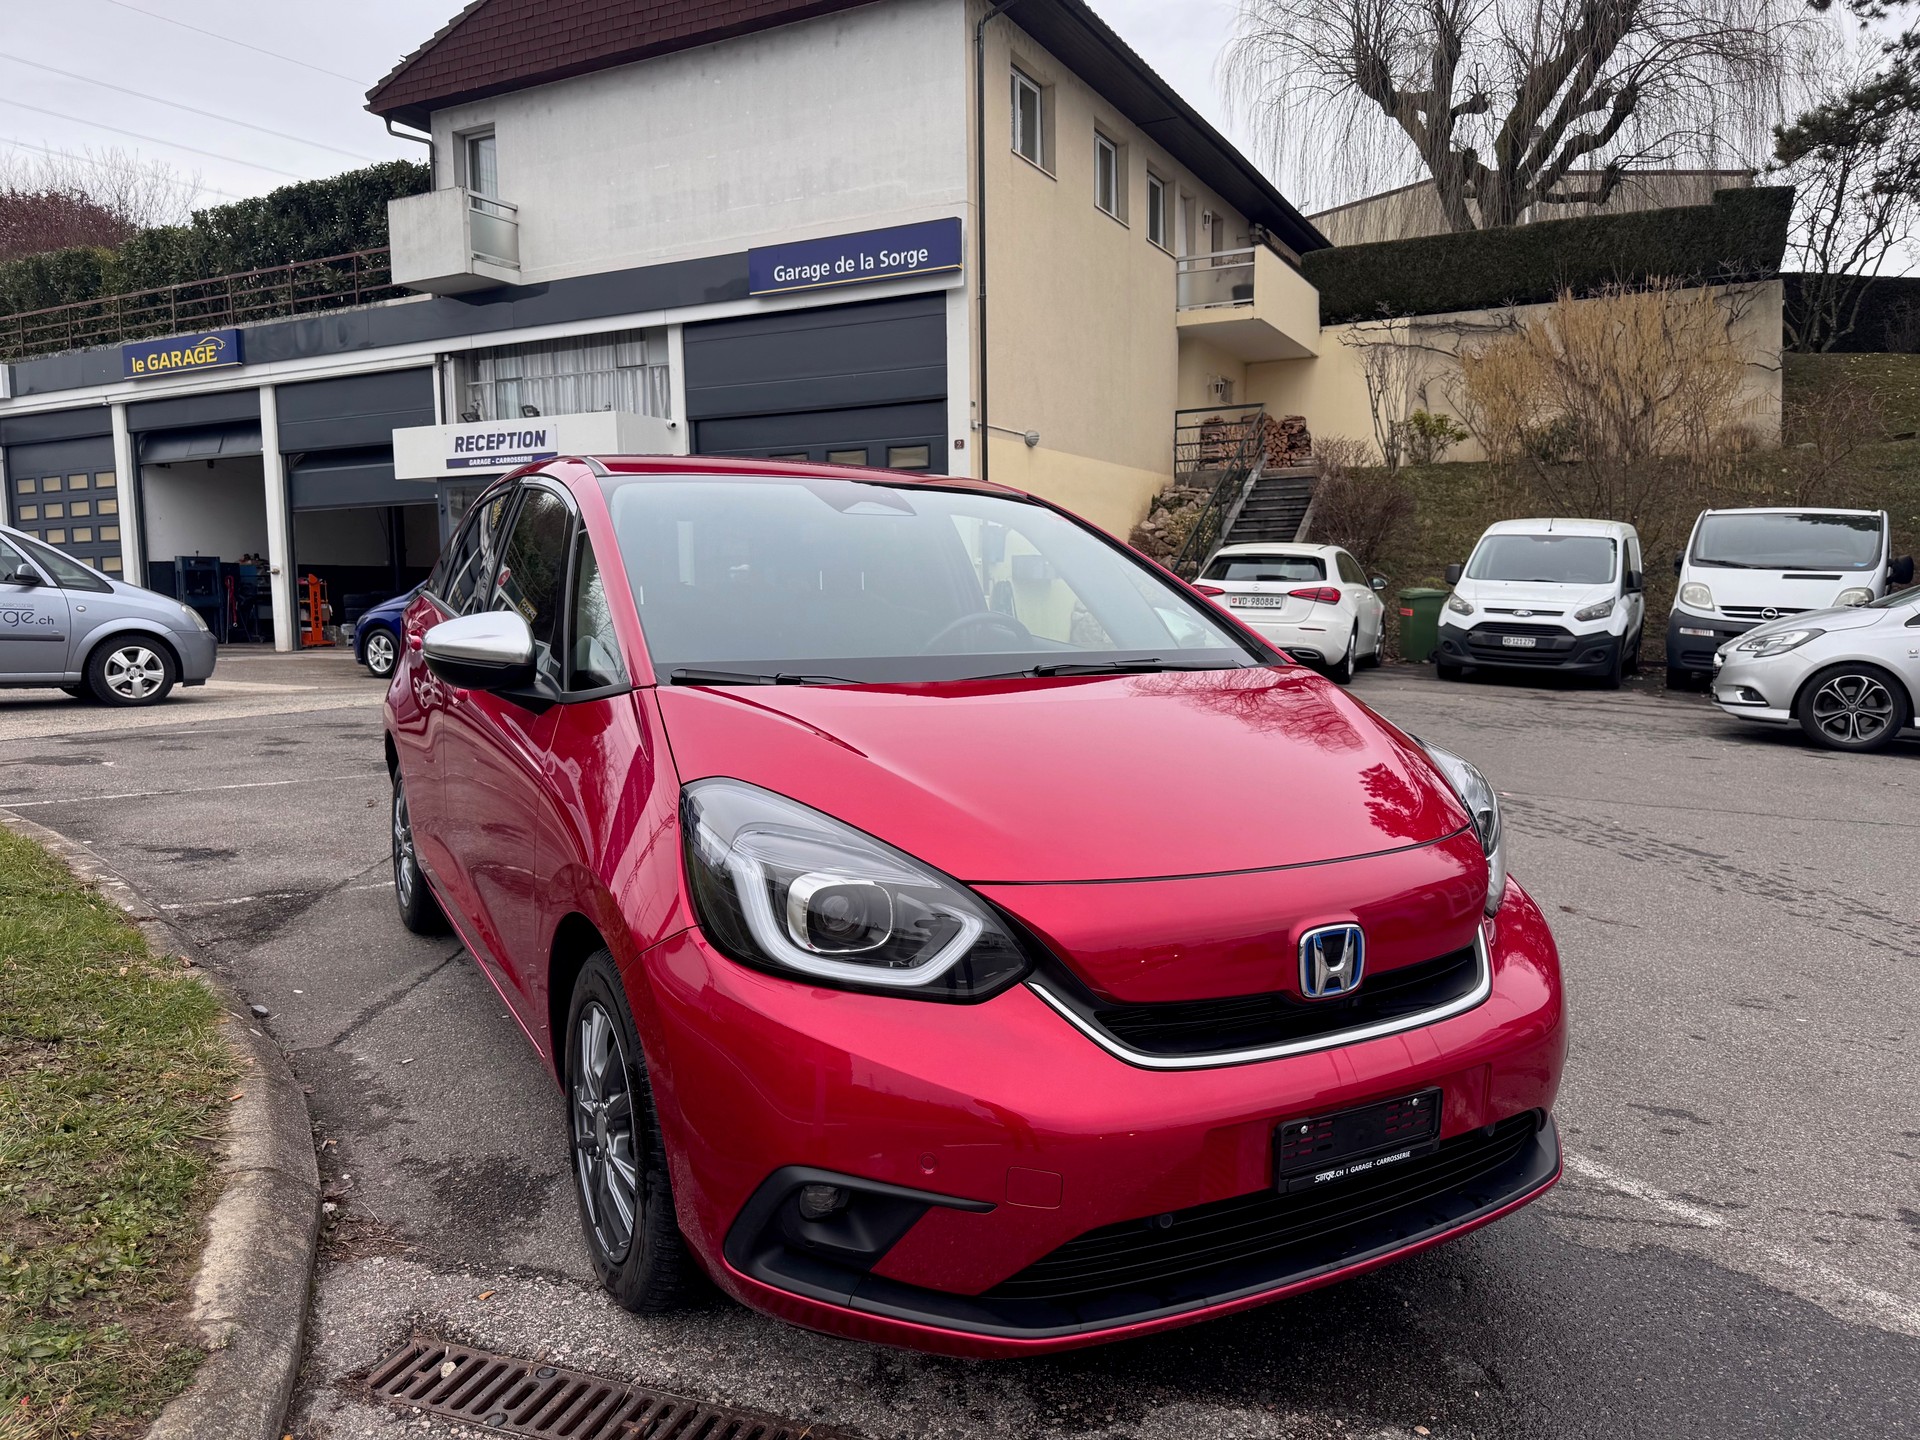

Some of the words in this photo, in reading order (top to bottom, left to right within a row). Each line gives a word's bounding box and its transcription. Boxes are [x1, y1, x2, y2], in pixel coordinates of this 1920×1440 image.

[773, 262, 830, 282] Garage
[834, 255, 855, 274] de
[860, 252, 874, 270] la
[879, 248, 929, 268] Sorge
[131, 357, 145, 373] le
[147, 345, 218, 371] GARAGE
[454, 430, 546, 453] RECEPTION
[469, 457, 491, 466] GARAGE
[495, 456, 533, 465] CARROSSERIE
[0, 611, 54, 627] ge.ch
[1350, 1161, 1373, 1173] GARAGE
[1376, 1150, 1411, 1166] CARROSSERIE
